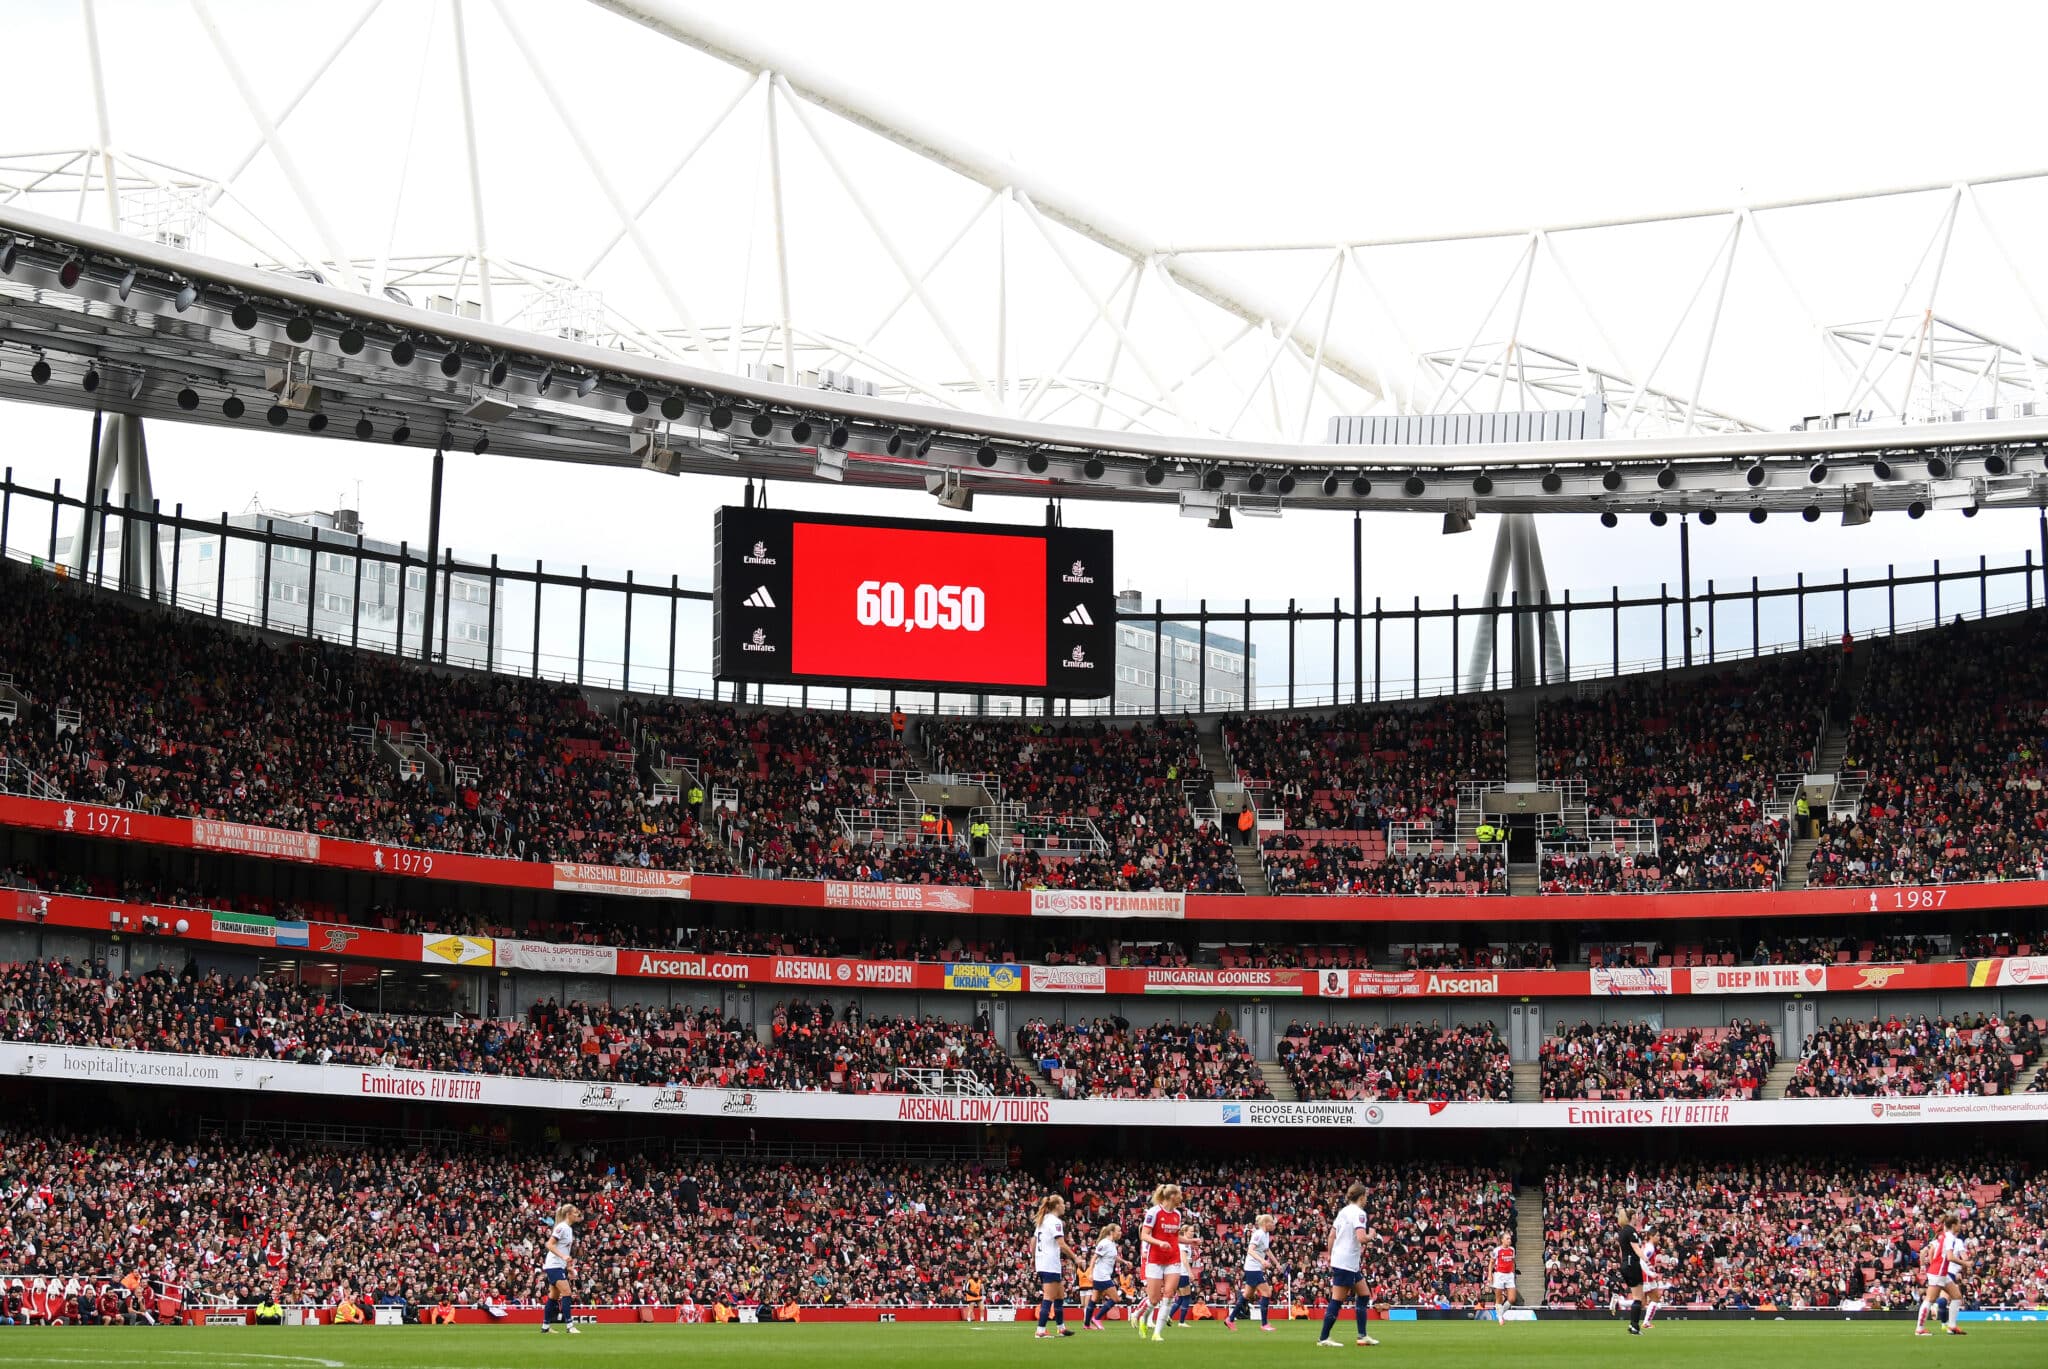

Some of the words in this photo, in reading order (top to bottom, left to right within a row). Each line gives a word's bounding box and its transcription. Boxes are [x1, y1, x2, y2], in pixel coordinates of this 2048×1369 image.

[743, 554, 776, 565] Emirates
[1062, 573, 1094, 584] Emirates
[856, 580, 985, 633] 60,050
[742, 641, 776, 652] Emirates
[1062, 658, 1094, 669] Emirates
[87, 811, 131, 836] 1971
[206, 823, 220, 835] WE
[223, 825, 244, 838] WON
[247, 827, 266, 841] THE
[268, 829, 304, 846] LEAGUE
[393, 852, 433, 874] 1979
[578, 865, 618, 881] ARSENAL
[620, 868, 666, 885] BULGARIA
[826, 882, 849, 899] MEN
[852, 884, 892, 900] BECAME
[894, 886, 922, 901] GODS
[1893, 889, 1947, 909] 1987
[827, 898, 849, 906] THE
[851, 899, 923, 909] INVINCIBLES
[1035, 893, 1087, 912] CLSS
[1090, 895, 1102, 910] IS
[1105, 896, 1181, 912] PERMANENT
[219, 921, 242, 933] IRANIAN
[243, 924, 269, 936] GUNNERS
[520, 944, 551, 954] ARSENAL
[552, 946, 594, 957] SUPPORTERS
[595, 950, 613, 958] CLUB
[639, 954, 749, 979] Arsenal.com
[775, 960, 832, 980] ARSENAL
[856, 964, 913, 983] SWEDEN
[953, 964, 990, 976] ARSENAL
[953, 976, 990, 988] UKRAINE
[1049, 968, 1104, 984] Arsenal
[1148, 971, 1214, 984] HUNGARIAN
[1217, 971, 1271, 984] GOONERS
[1425, 974, 1499, 993] Arsenal
[1613, 970, 1668, 986] Arsenal
[1717, 972, 1751, 987] DEEP
[1754, 971, 1769, 986] IN
[1773, 970, 1800, 986] THE
[64, 1053, 219, 1080] hospitality.arsenal.com
[361, 1073, 425, 1096] Emirates
[431, 1078, 447, 1097] FLY
[449, 1079, 481, 1100] BETTER
[898, 1098, 1049, 1122] ARSENAL.COM/TOURS
[1249, 1105, 1293, 1114] CHOOSE
[1295, 1105, 1357, 1115] ALUMINIUM.
[1250, 1114, 1304, 1124] RECYCLES
[1306, 1115, 1356, 1124] FOREVER.
[1568, 1106, 1653, 1124] Emirates
[1661, 1106, 1681, 1123] FLY
[1684, 1105, 1729, 1123] BETTER
